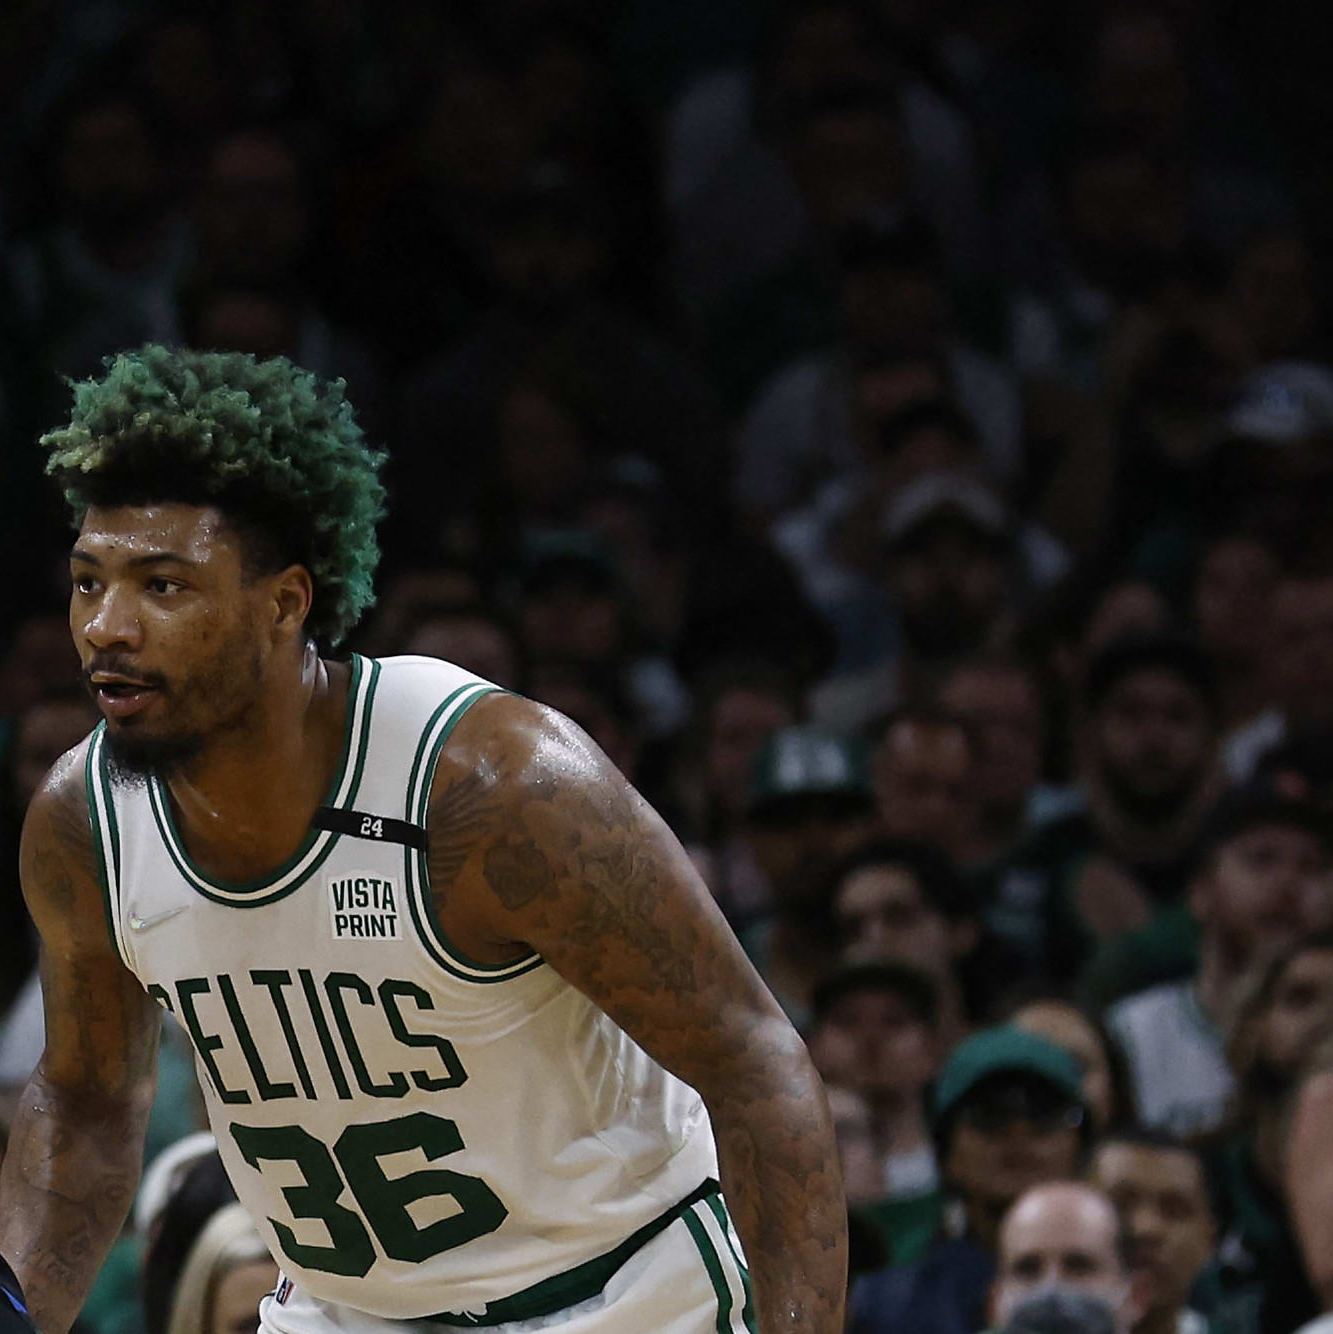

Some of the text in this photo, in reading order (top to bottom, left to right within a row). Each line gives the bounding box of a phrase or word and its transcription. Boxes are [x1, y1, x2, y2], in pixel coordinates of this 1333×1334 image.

[359, 816, 384, 838] 24
[331, 877, 397, 913] VISTA
[334, 913, 398, 937] PRINT
[228, 1111, 509, 1279] 36
